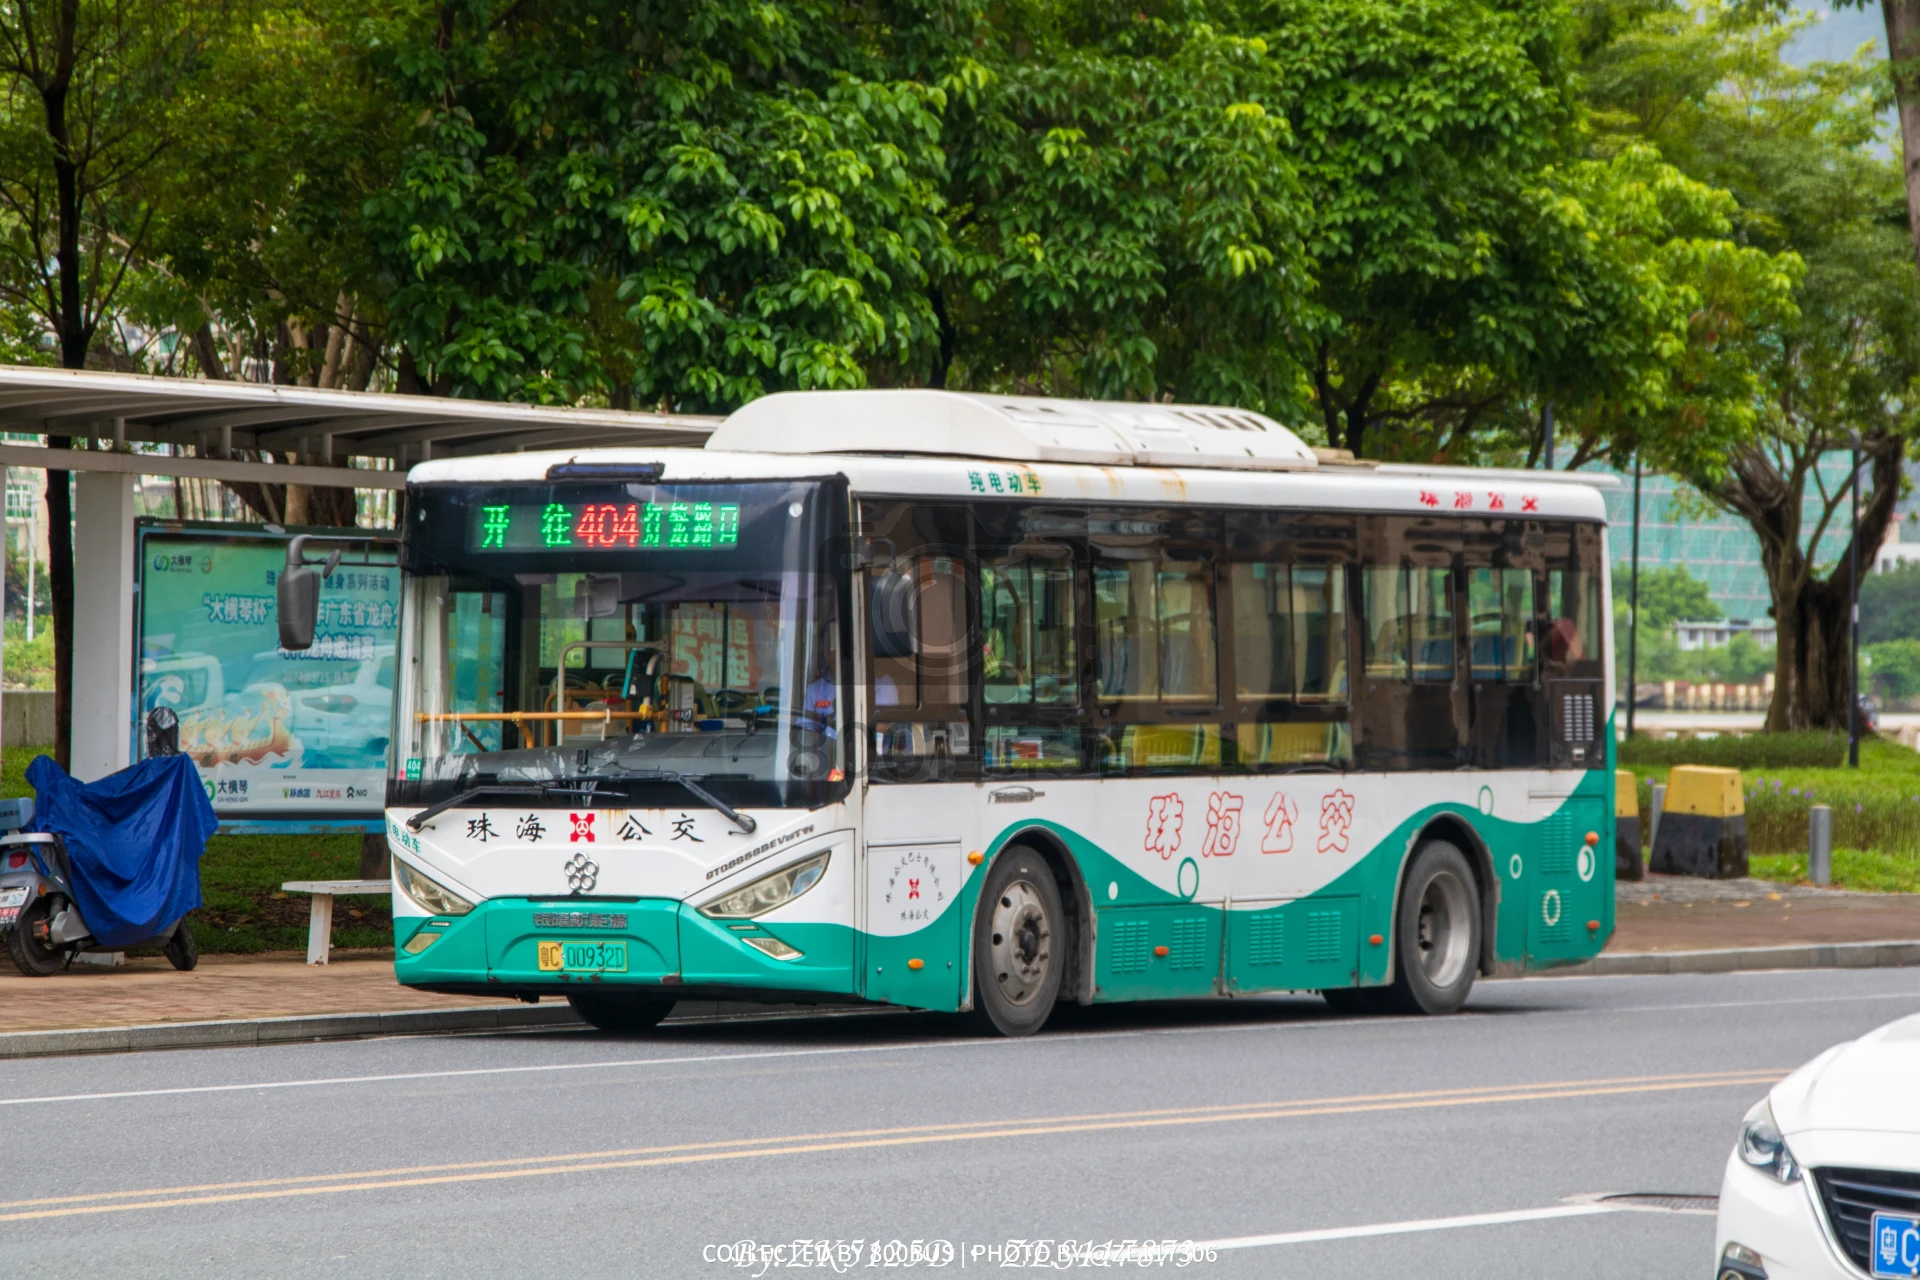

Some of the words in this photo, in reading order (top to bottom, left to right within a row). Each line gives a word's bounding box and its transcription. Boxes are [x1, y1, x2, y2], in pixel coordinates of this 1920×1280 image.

[968, 470, 1041, 494] 纯电动车
[1420, 490, 1539, 511] 珠海公交
[576, 504, 640, 547] 404
[407, 760, 421, 771] 404
[217, 779, 248, 795] 大横琴
[356, 789, 368, 797] NIO
[467, 812, 704, 843] 珠海公交
[1144, 788, 1355, 861] 珠海公交
[1880, 1226, 1919, 1268] 粤C
